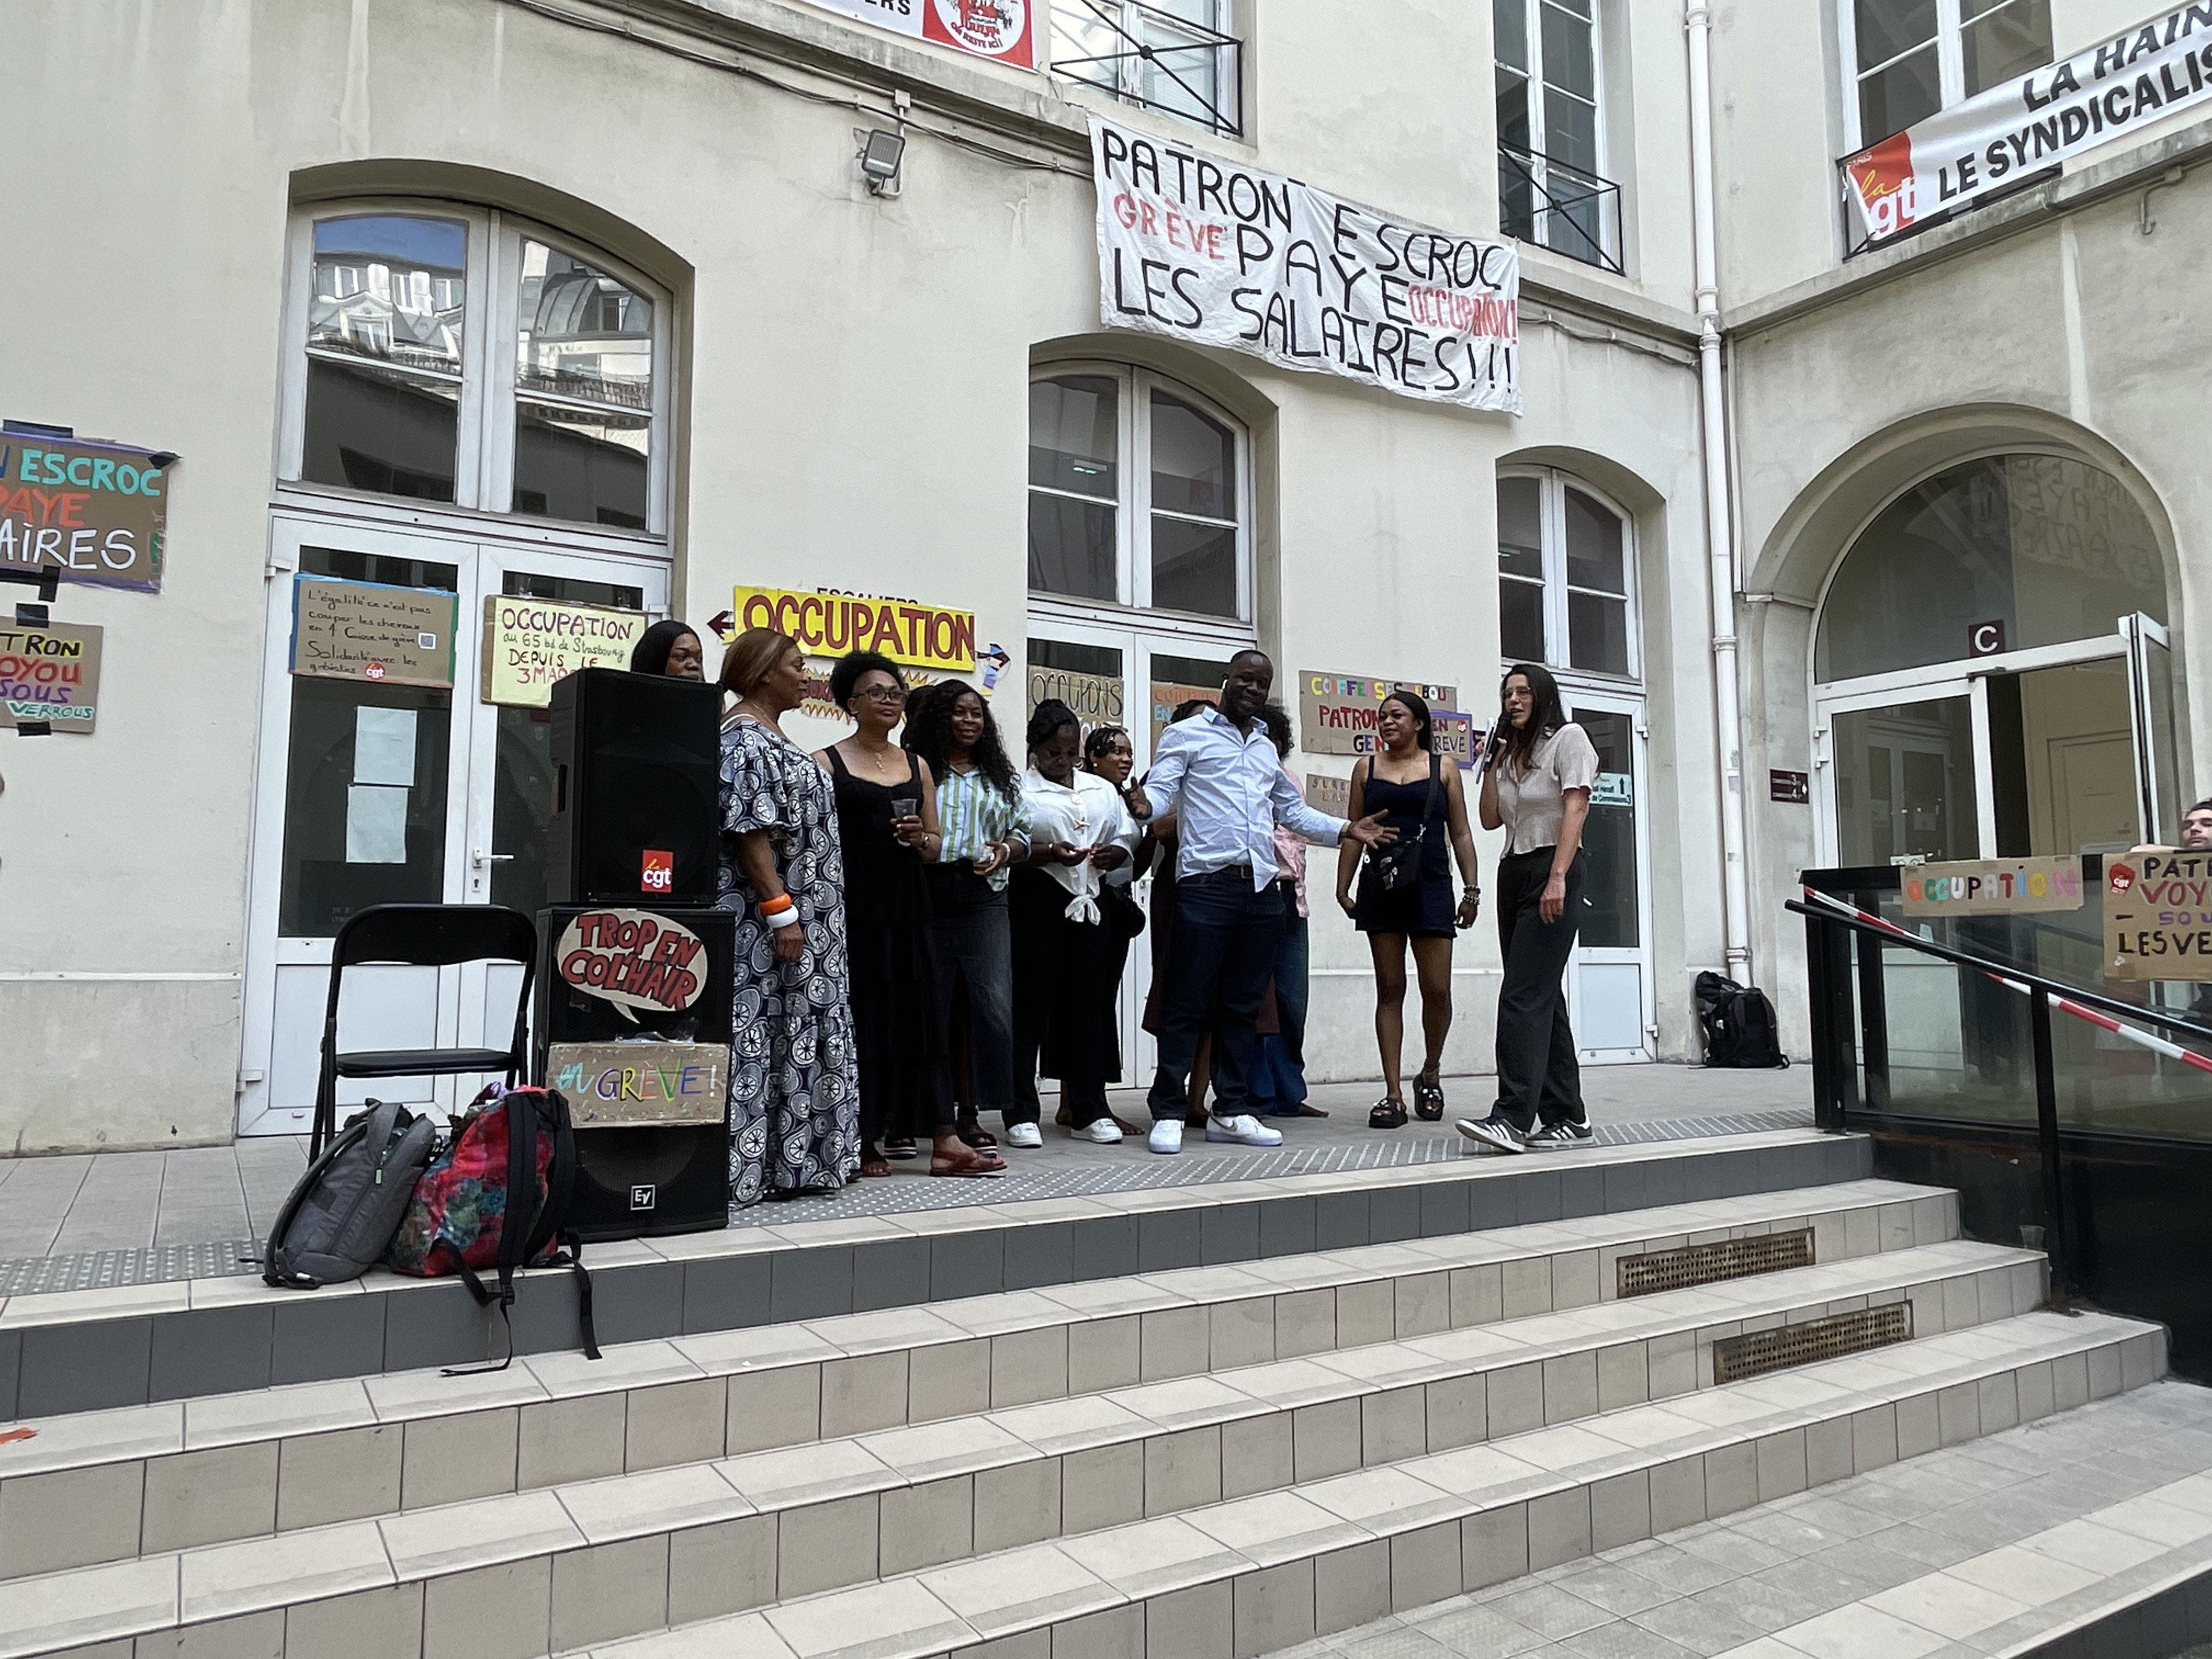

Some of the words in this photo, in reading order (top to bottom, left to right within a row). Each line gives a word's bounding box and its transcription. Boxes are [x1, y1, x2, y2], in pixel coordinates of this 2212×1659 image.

[2023, 64, 2081, 112] LA
[1939, 153, 1979, 202] LE
[1103, 127, 1291, 233] PATRON
[1334, 204, 1504, 291] ESCROC
[1114, 193, 1226, 261] GRÈVE
[1114, 247, 1203, 329] LES
[1237, 224, 1412, 326] PAYE
[20, 448, 162, 496] ESCROC
[359, 614, 374, 625] les
[377, 618, 420, 630] cheveux
[409, 606, 431, 615] pas
[502, 607, 634, 640] OCCUPATION
[743, 594, 976, 662] OCCUPATION
[503, 633, 518, 643] au
[522, 633, 541, 648] 65
[558, 638, 569, 651] de
[573, 636, 625, 664] Strasbourg
[507, 648, 565, 668] DEPUIS
[1974, 625, 1999, 653] C
[403, 654, 417, 666] les
[533, 665, 578, 685] MAR
[5, 700, 95, 720] VERROUS
[1031, 672, 1123, 717] OCCUPONS
[643, 867, 672, 889] cgt
[2137, 879, 2212, 906] VOY
[576, 913, 658, 955] TROP
[651, 929, 703, 967] EN
[595, 1057, 703, 1103] GRÈVE
